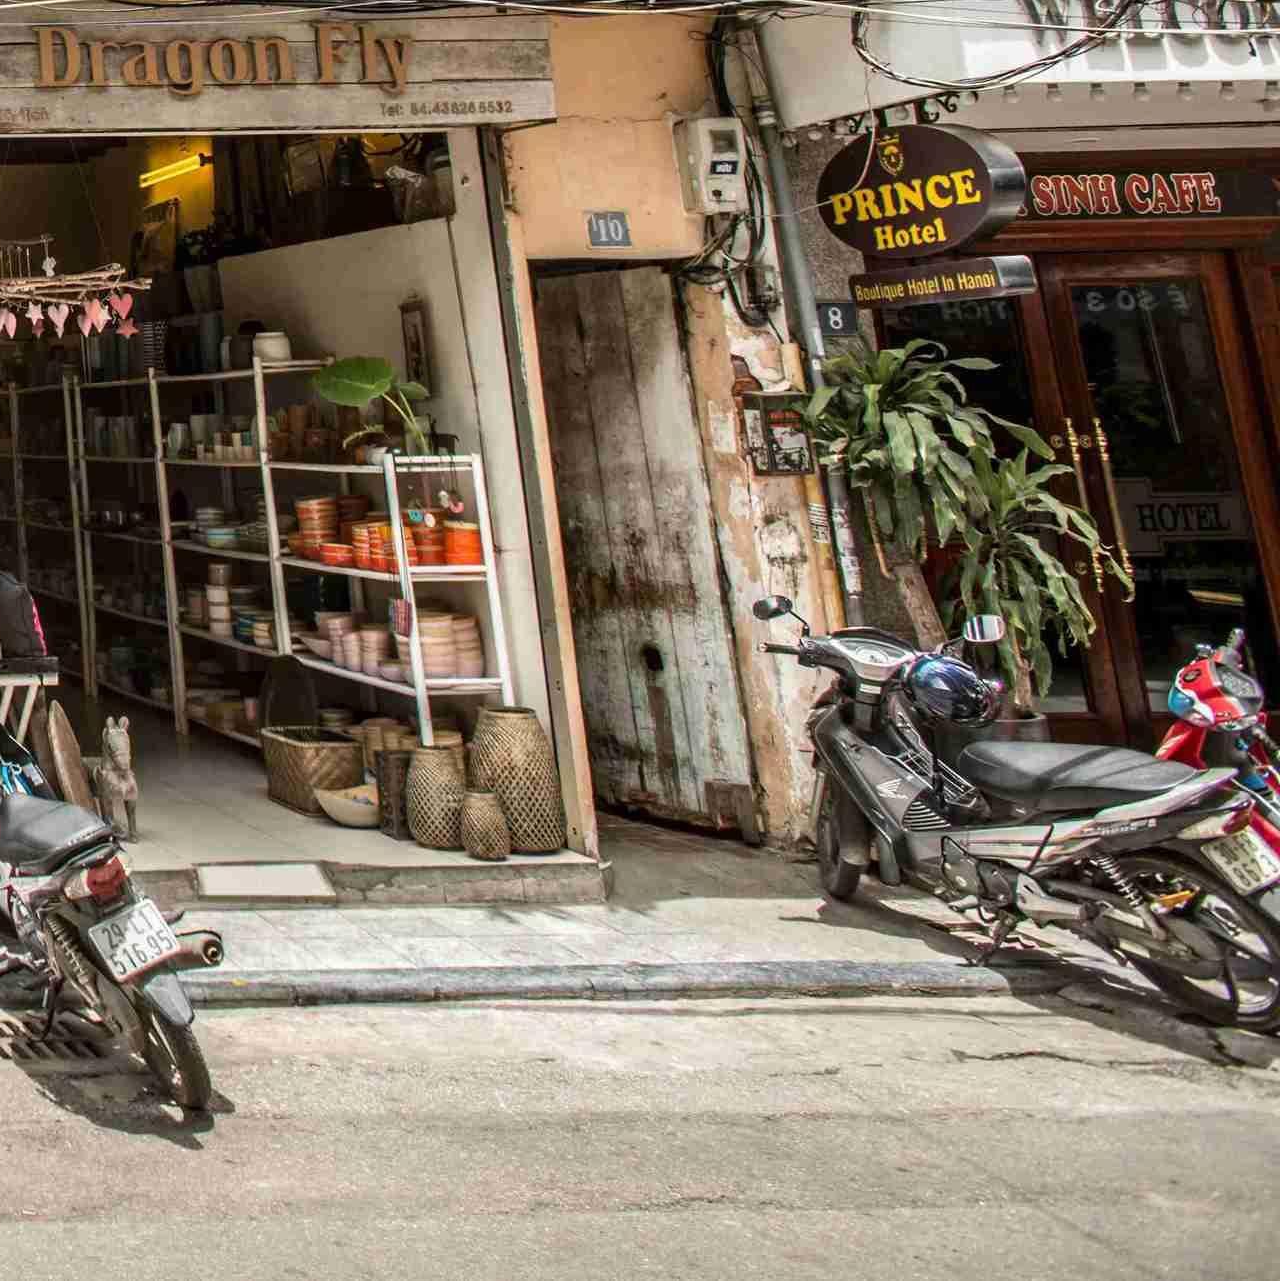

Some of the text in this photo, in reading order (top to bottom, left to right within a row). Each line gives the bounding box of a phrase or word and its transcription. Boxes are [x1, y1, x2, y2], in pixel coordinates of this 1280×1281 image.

[32, 20, 413, 97] Dragon Fly
[830, 168, 982, 224] PRINCE
[1031, 171, 1221, 216] SINH CAFE
[873, 217, 948, 251] Hotel
[855, 281, 905, 303] Boutique
[907, 275, 940, 296] Hotel
[956, 270, 996, 290] Hanoi
[827, 306, 844, 330] 8
[1135, 502, 1231, 532] HOTEL
